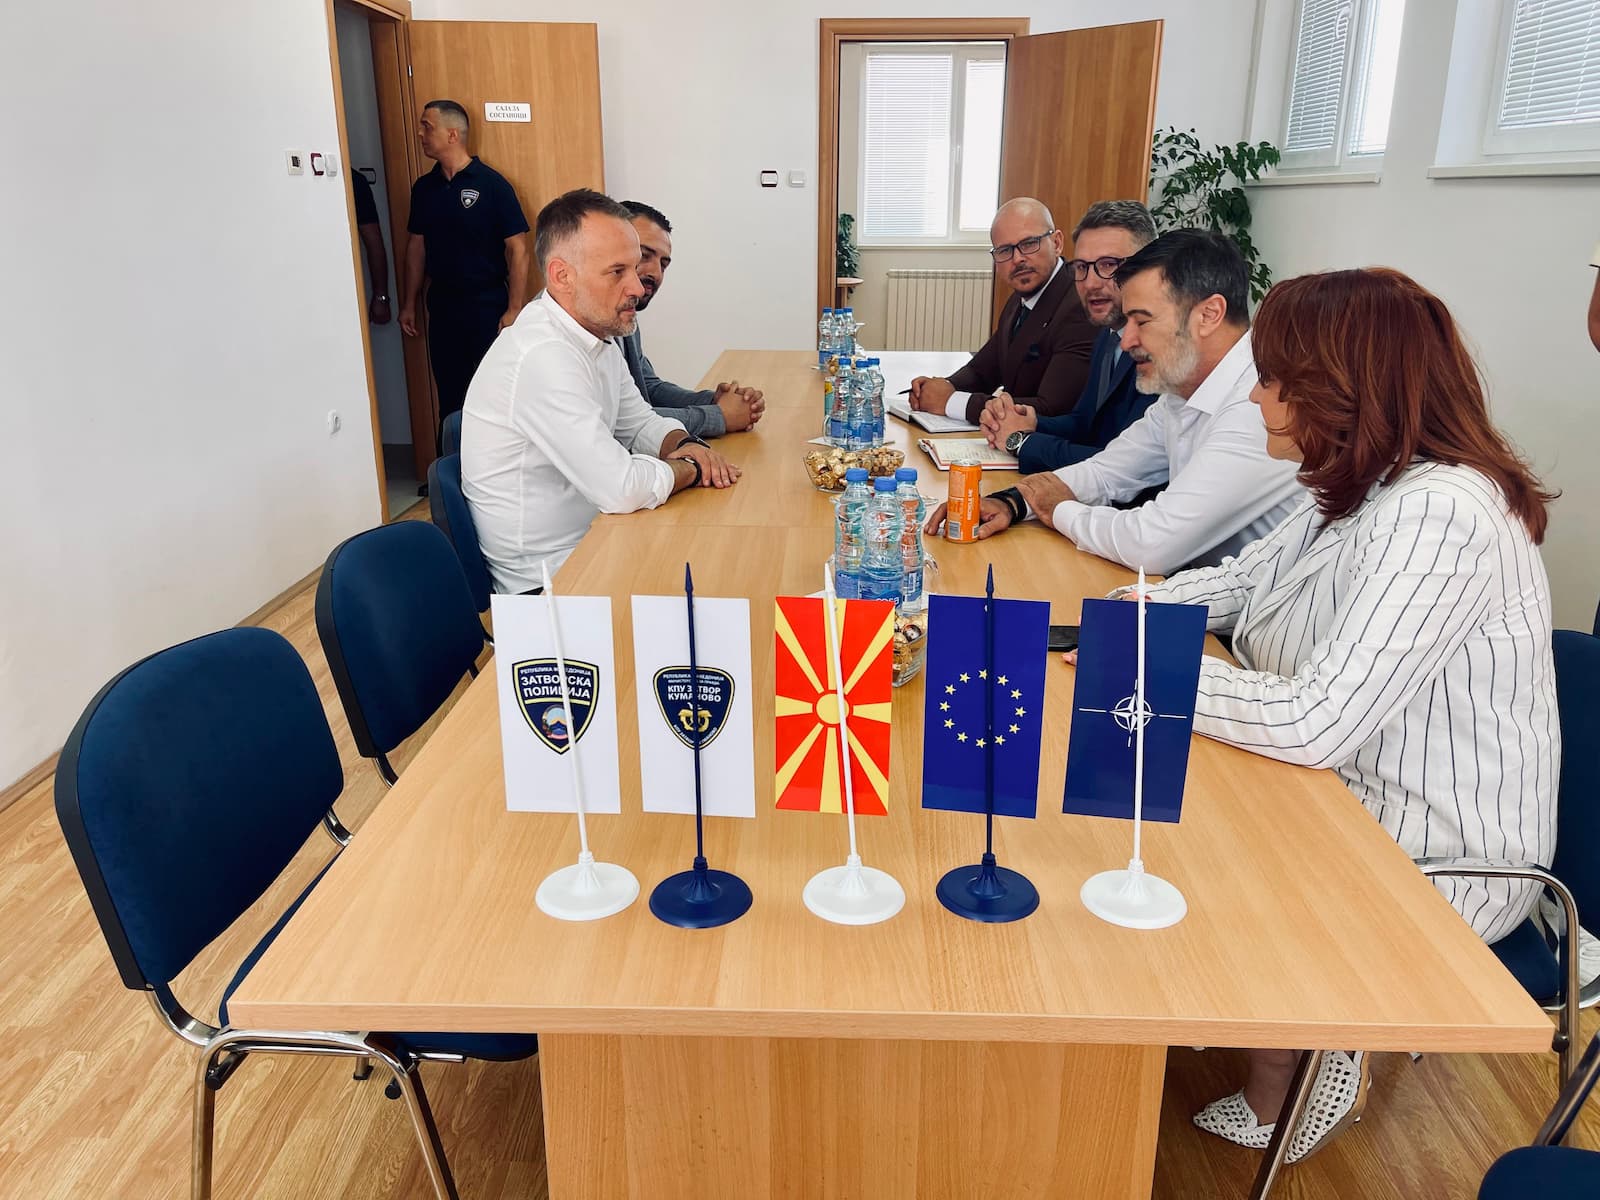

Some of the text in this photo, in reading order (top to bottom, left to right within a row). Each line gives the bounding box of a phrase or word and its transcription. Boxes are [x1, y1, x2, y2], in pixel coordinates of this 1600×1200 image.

[521, 675, 592, 688] ЗАТВОСКА
[667, 685, 721, 694] КПУ ЗТВОР
